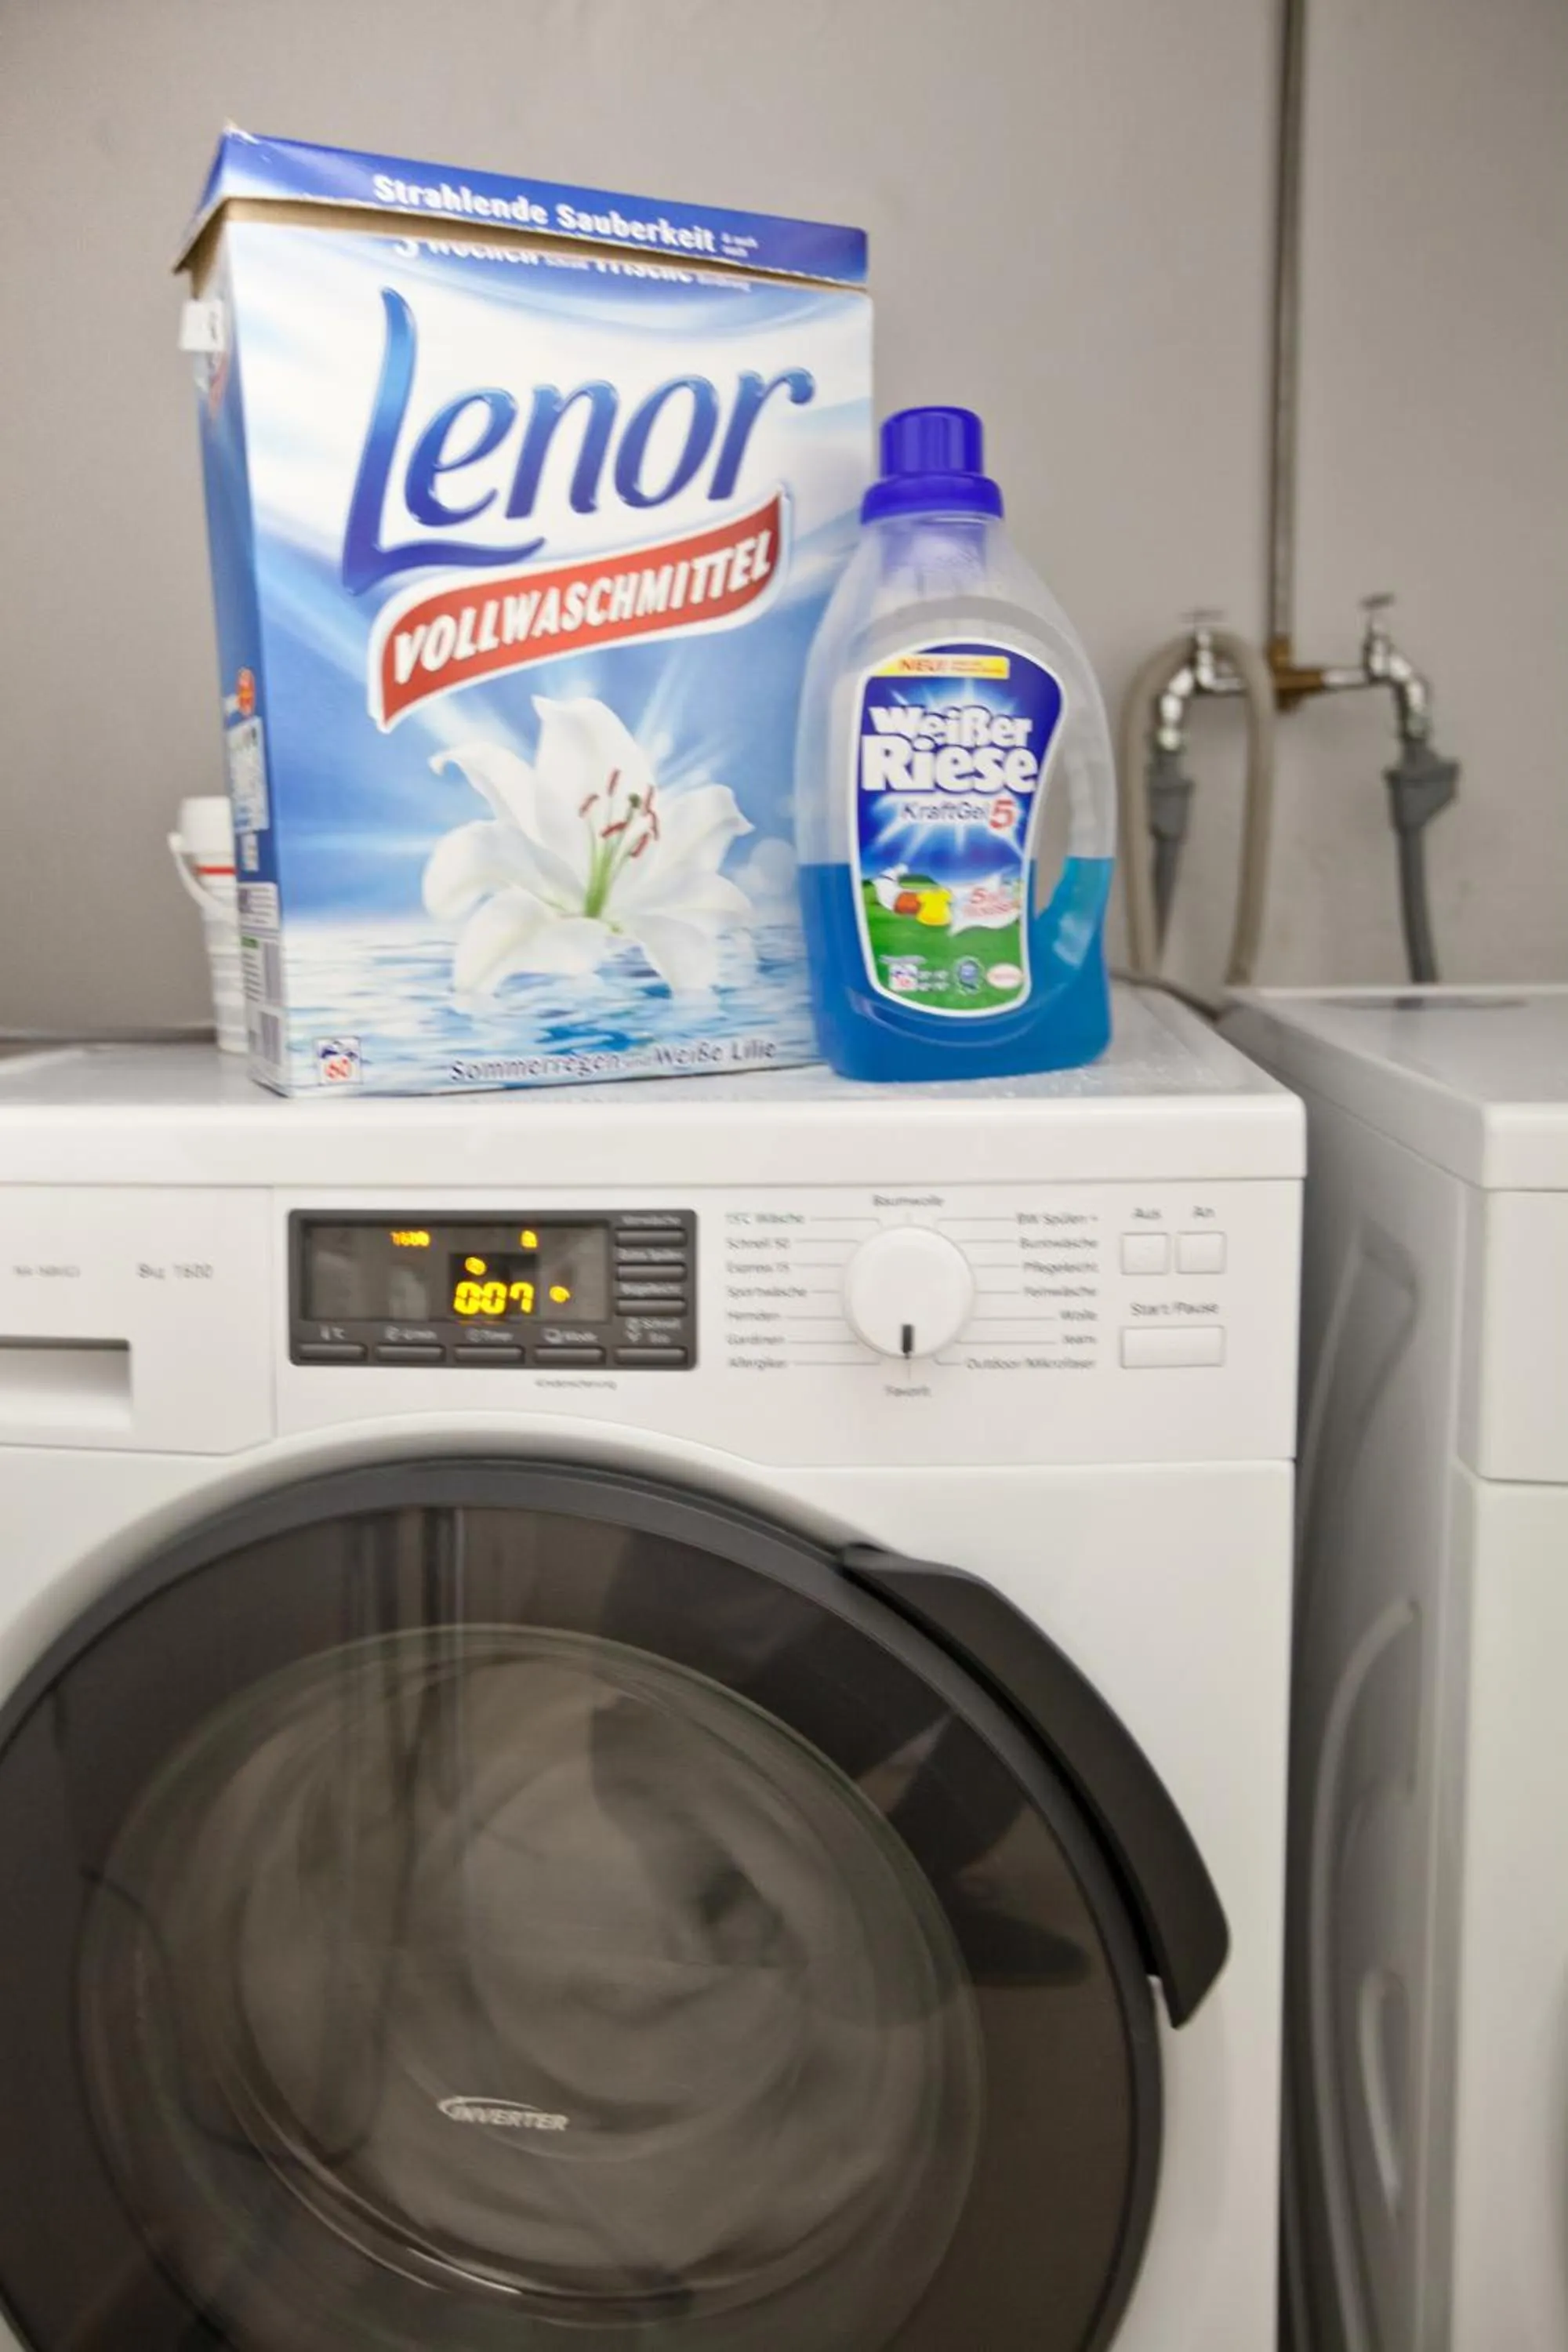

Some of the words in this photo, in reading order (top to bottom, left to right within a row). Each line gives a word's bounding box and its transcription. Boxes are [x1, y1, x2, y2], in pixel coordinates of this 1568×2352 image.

[372, 175, 548, 225] Strahlende
[555, 203, 716, 252] Sauberkeit
[342, 287, 815, 596] Lenor
[393, 530, 772, 684] VOLLWASCHMITTEL
[869, 706, 1033, 746] Weißer
[862, 735, 1038, 793] Riese
[442, 2100, 569, 2131] INVERTER
